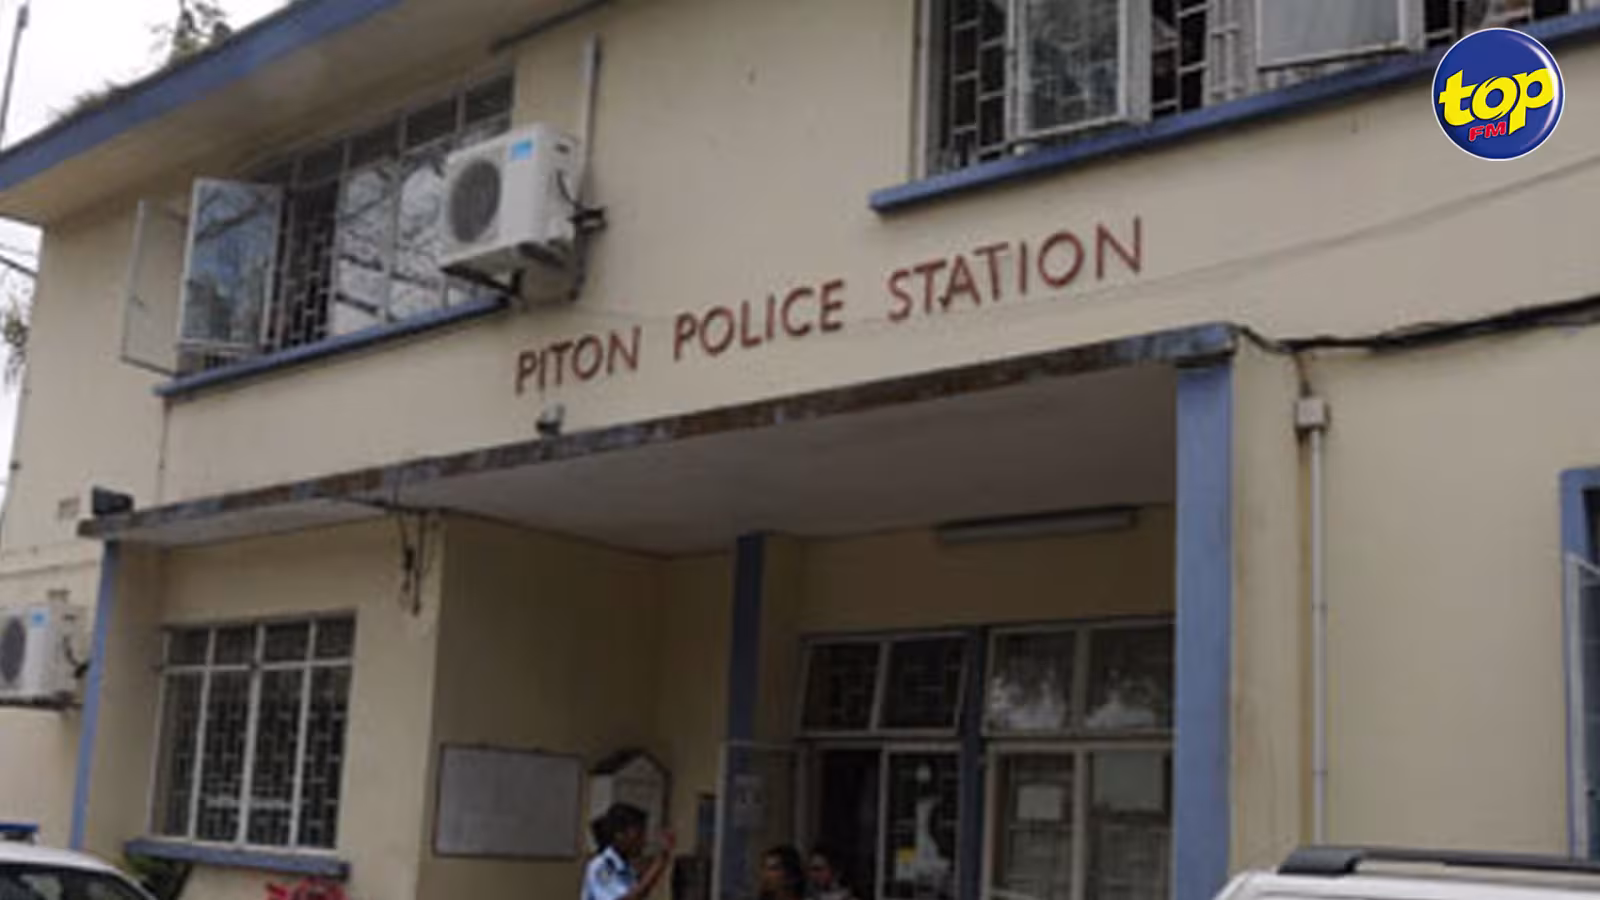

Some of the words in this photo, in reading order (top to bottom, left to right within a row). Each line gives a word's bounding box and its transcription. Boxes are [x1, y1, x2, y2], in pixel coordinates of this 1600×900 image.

[515, 326, 642, 394] PITON
[673, 279, 845, 361] POLICE
[887, 216, 1142, 323] STATION
